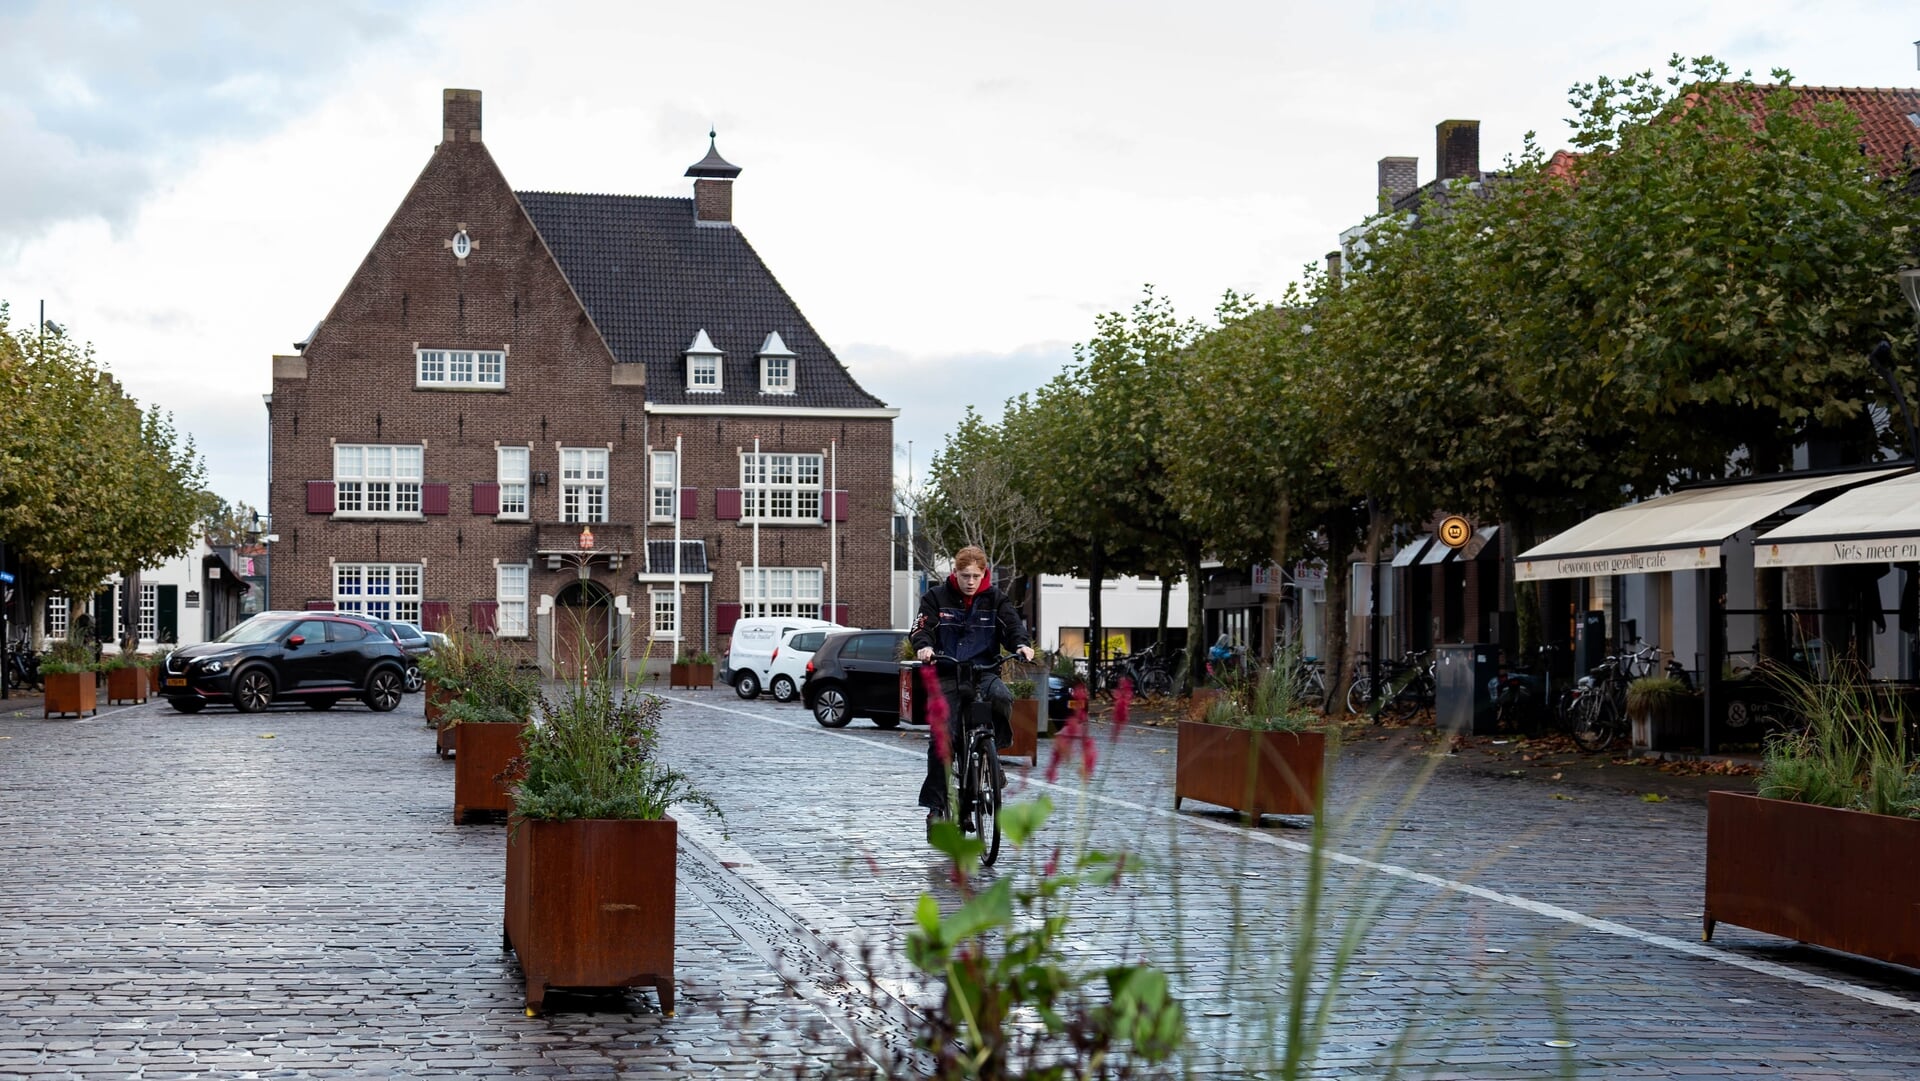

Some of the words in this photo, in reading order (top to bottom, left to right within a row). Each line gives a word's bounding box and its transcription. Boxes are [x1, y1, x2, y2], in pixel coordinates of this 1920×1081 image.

[1833, 543, 1862, 560] Niets
[1866, 544, 1898, 559] meer
[1902, 543, 1917, 557] en
[1557, 559, 1592, 574] Gewoon
[1593, 560, 1609, 572] een
[1611, 554, 1644, 571] gezellig
[1646, 552, 1666, 568] café
